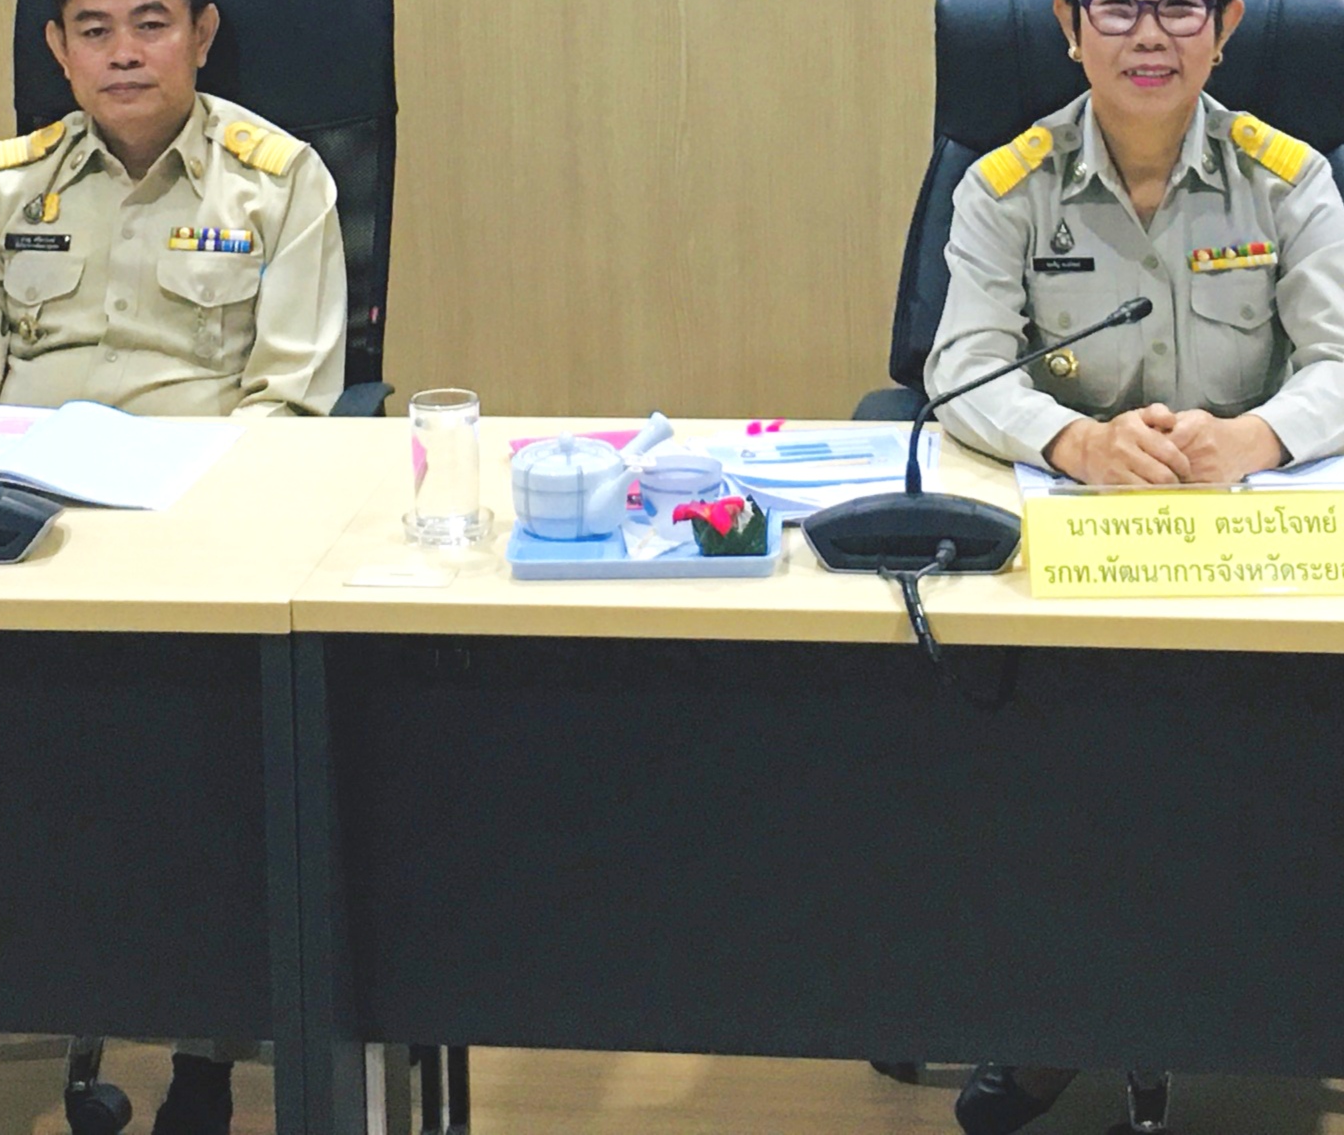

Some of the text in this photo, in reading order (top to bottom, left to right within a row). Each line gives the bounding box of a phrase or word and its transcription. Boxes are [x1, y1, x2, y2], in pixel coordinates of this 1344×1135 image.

[1067, 505, 1337, 543] นางพรเพ็ญ ตะปะโจทย์
